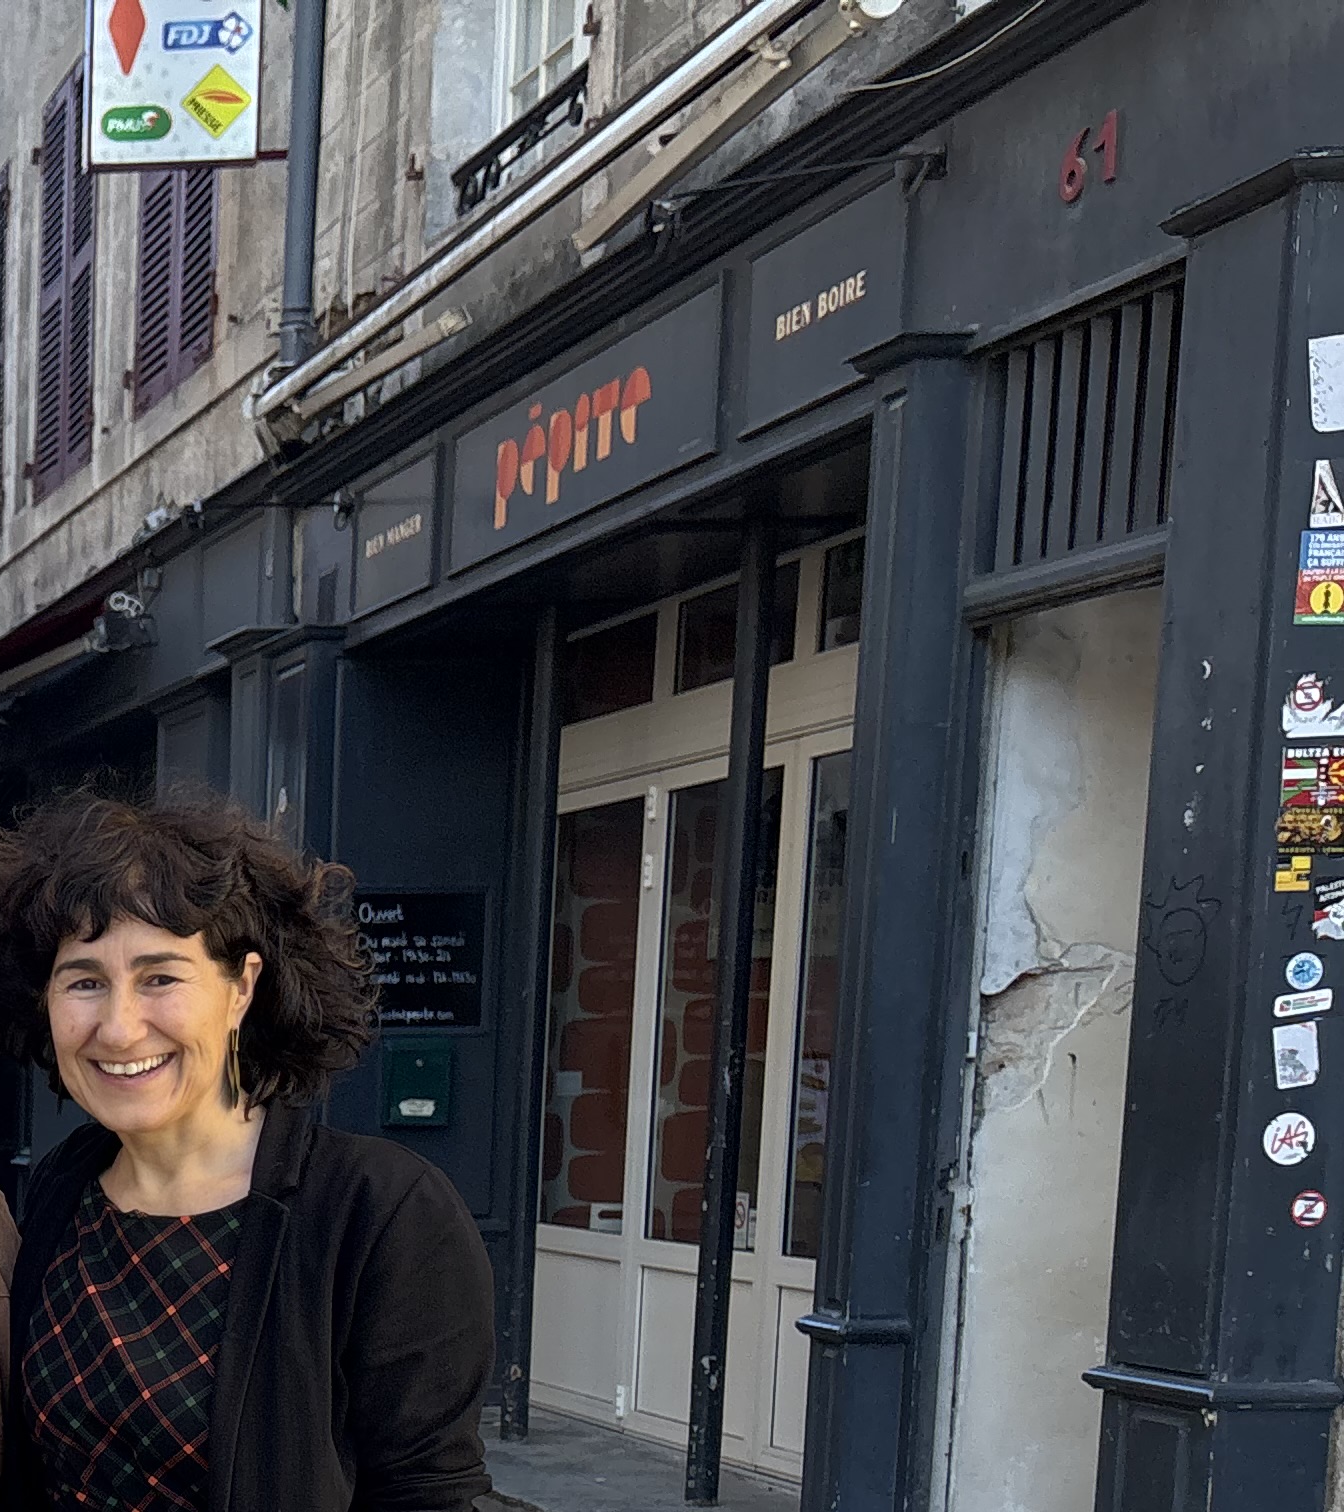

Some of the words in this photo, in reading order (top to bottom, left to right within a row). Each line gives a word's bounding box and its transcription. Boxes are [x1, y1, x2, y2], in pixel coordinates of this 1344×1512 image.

[167, 24, 212, 46] FDJ
[1059, 109, 1118, 206] 61
[775, 300, 812, 341] BIEN
[817, 269, 868, 320] BOIRE
